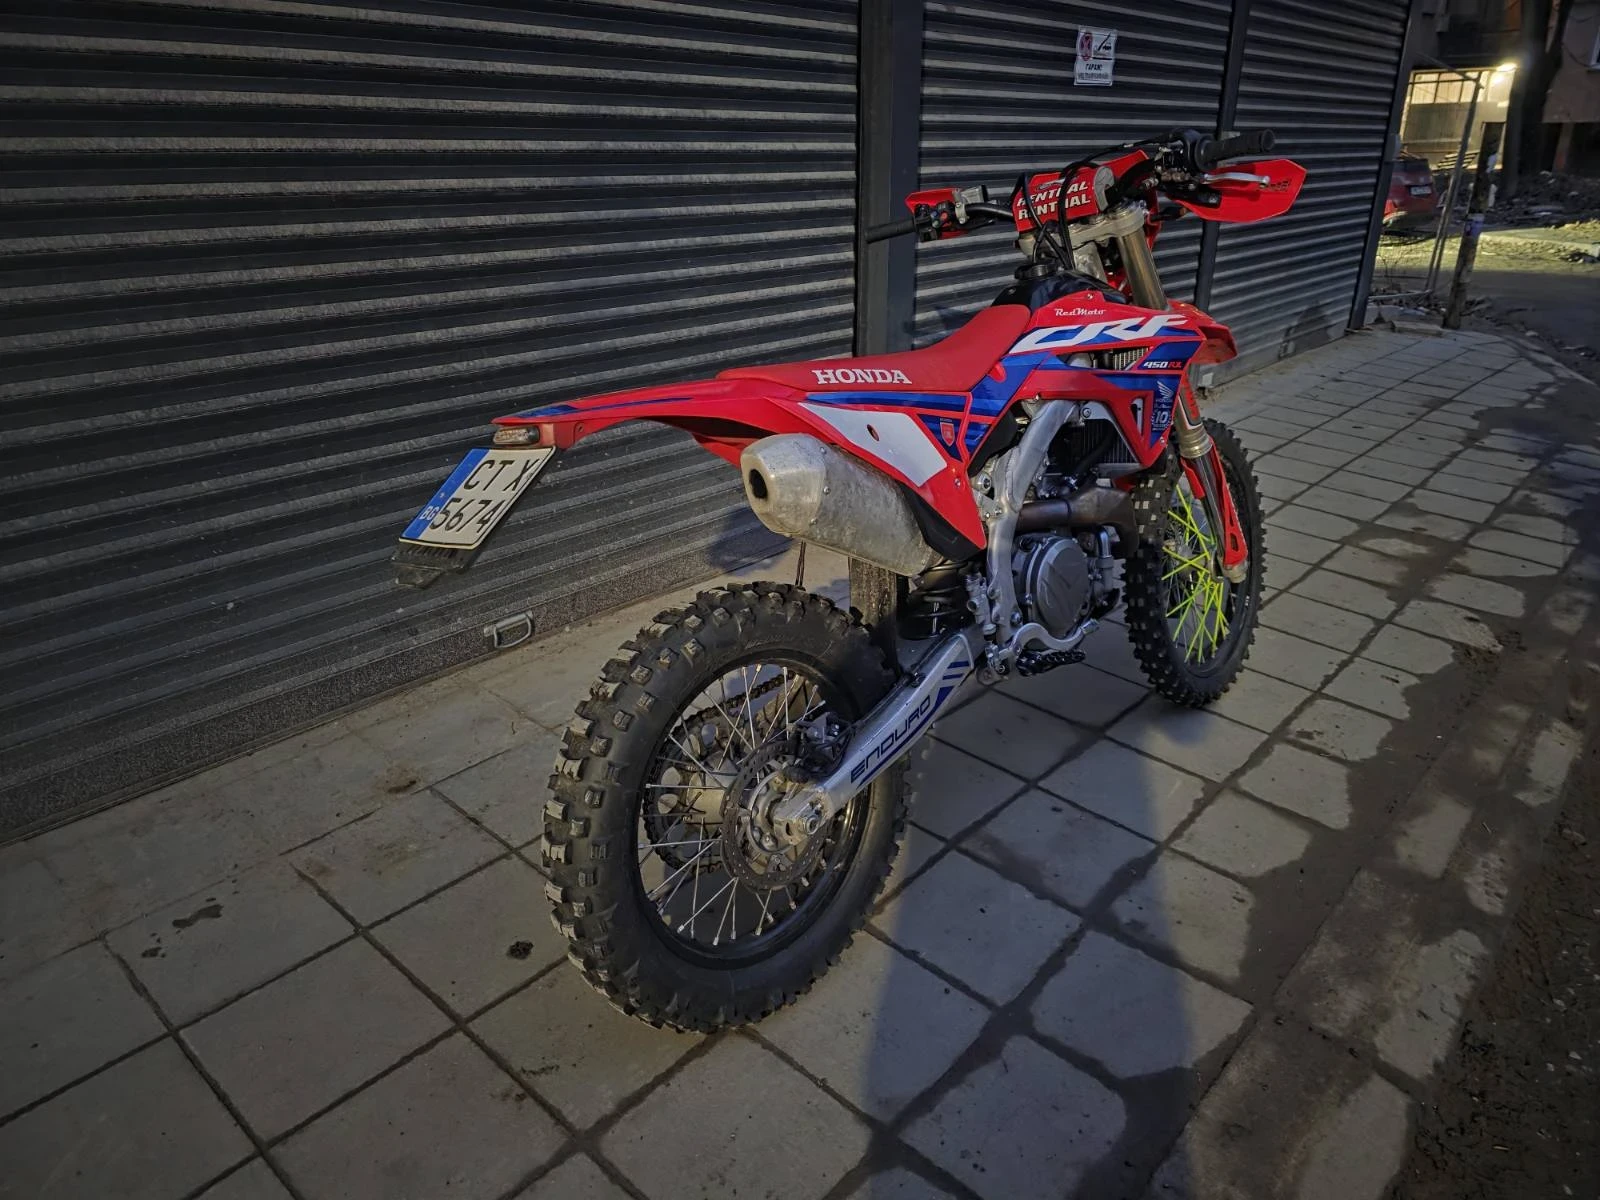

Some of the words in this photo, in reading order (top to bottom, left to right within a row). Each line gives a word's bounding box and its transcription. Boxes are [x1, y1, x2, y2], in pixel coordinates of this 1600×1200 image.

[1018, 193, 1091, 220] RNTAL
[1054, 307, 1107, 317] RedMoto
[1008, 314, 1189, 354] CRF
[811, 368, 913, 385] HONDA
[419, 505, 440, 521] BG
[428, 497, 505, 534] 5674
[850, 694, 931, 784] ENDURO
